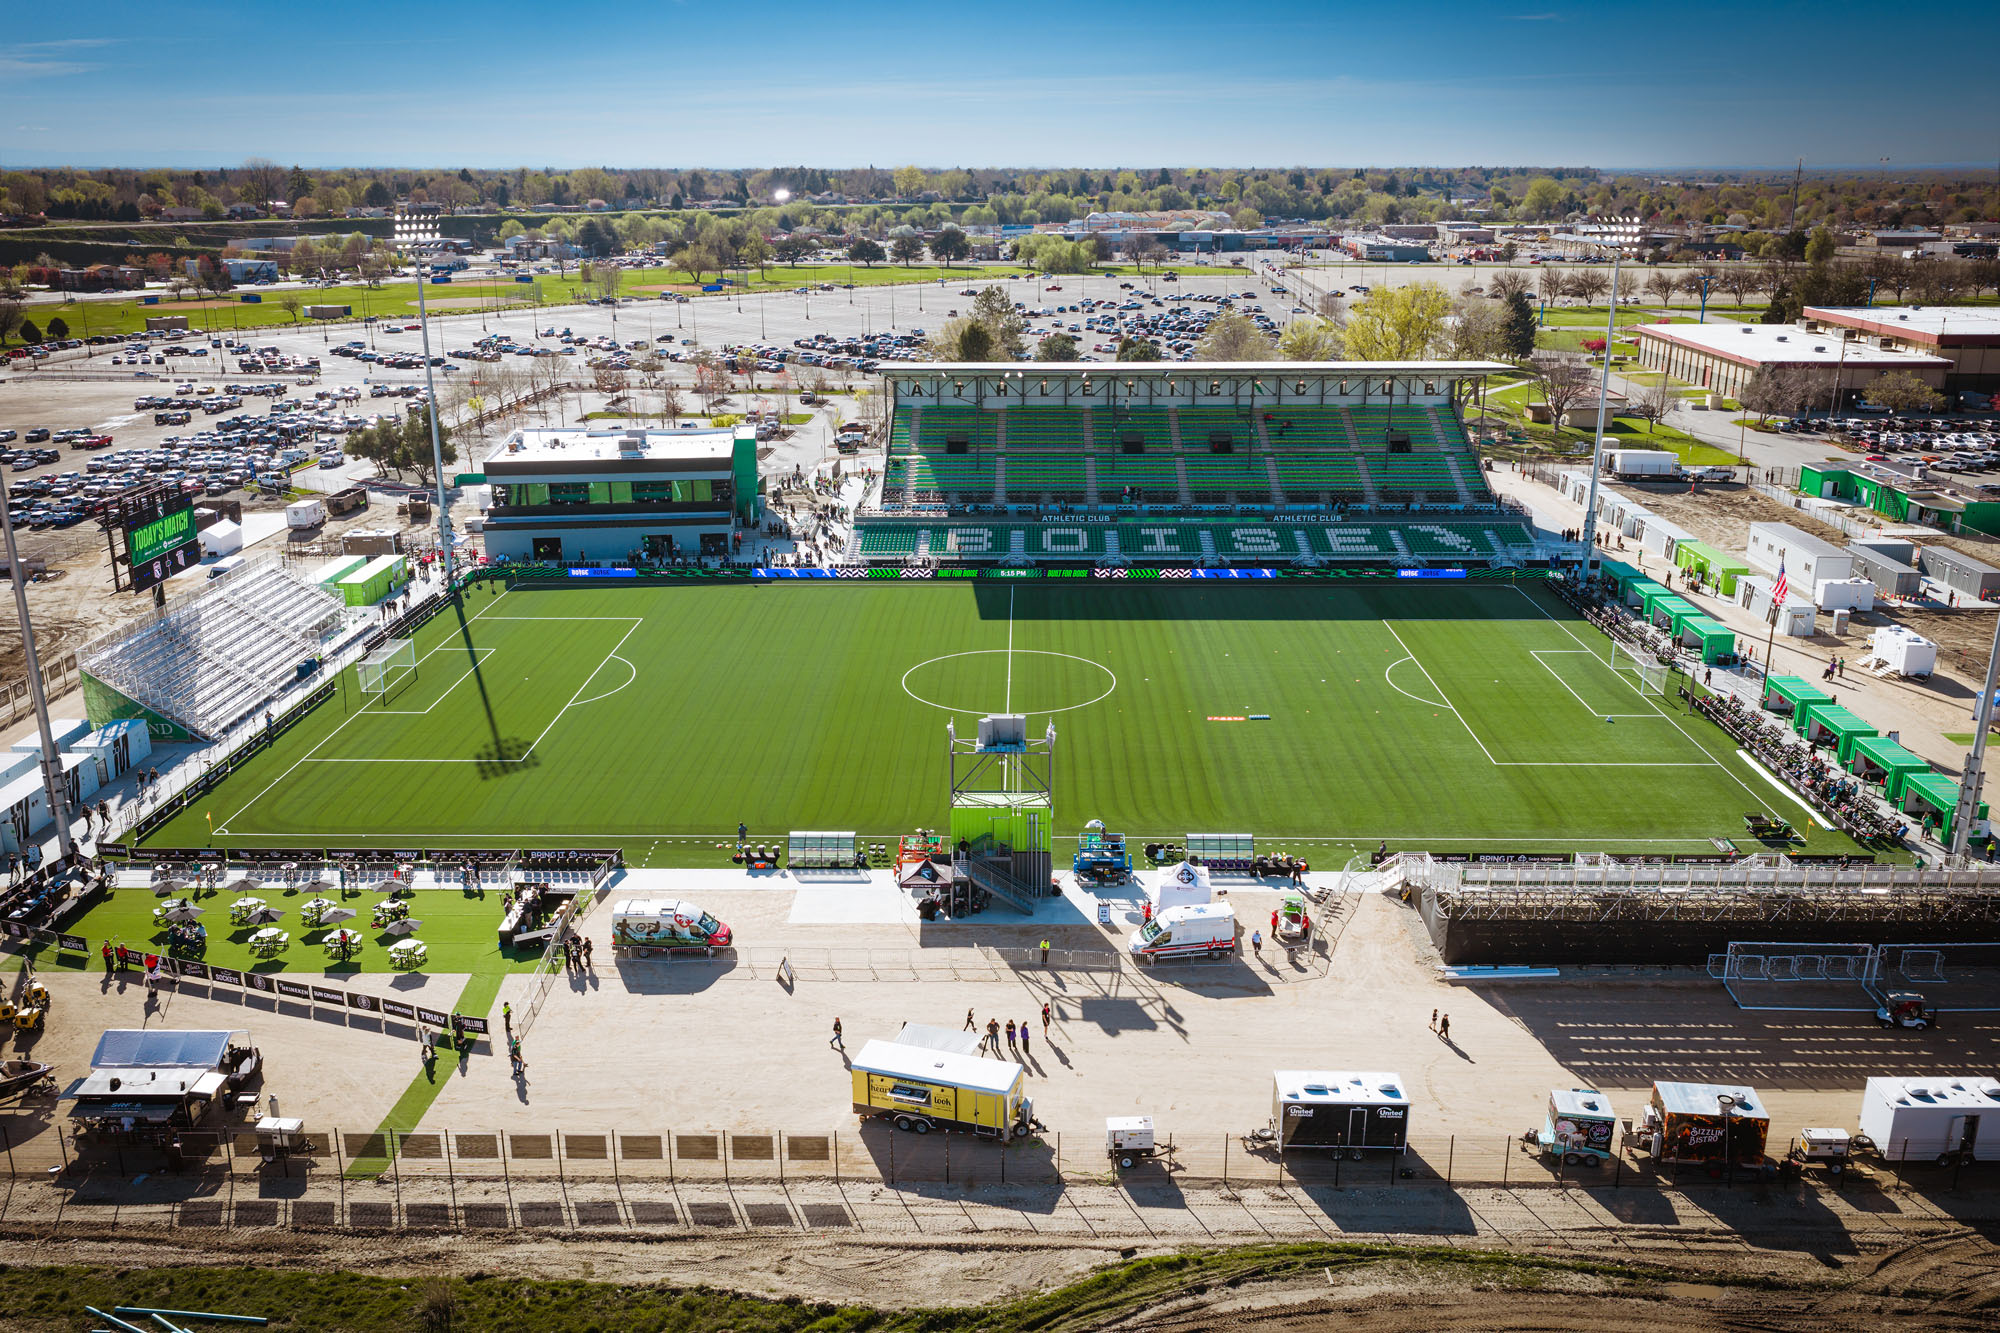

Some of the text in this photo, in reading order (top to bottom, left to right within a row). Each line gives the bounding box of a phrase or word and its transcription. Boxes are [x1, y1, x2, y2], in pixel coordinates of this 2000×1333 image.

[134, 510, 189, 551] TODAY'S MATCH
[937, 569, 979, 577] BUILT FOR BOISE
[1047, 569, 1088, 577] BUILT FOR BOISE
[531, 851, 556, 859] BRING
[62, 940, 85, 951] SOCKEYE
[215, 973, 239, 984] SOCKEYE
[281, 985, 309, 996] HEINEKEN
[419, 1011, 445, 1024] TRULY
[1689, 1135, 1718, 1145] BISTRO
